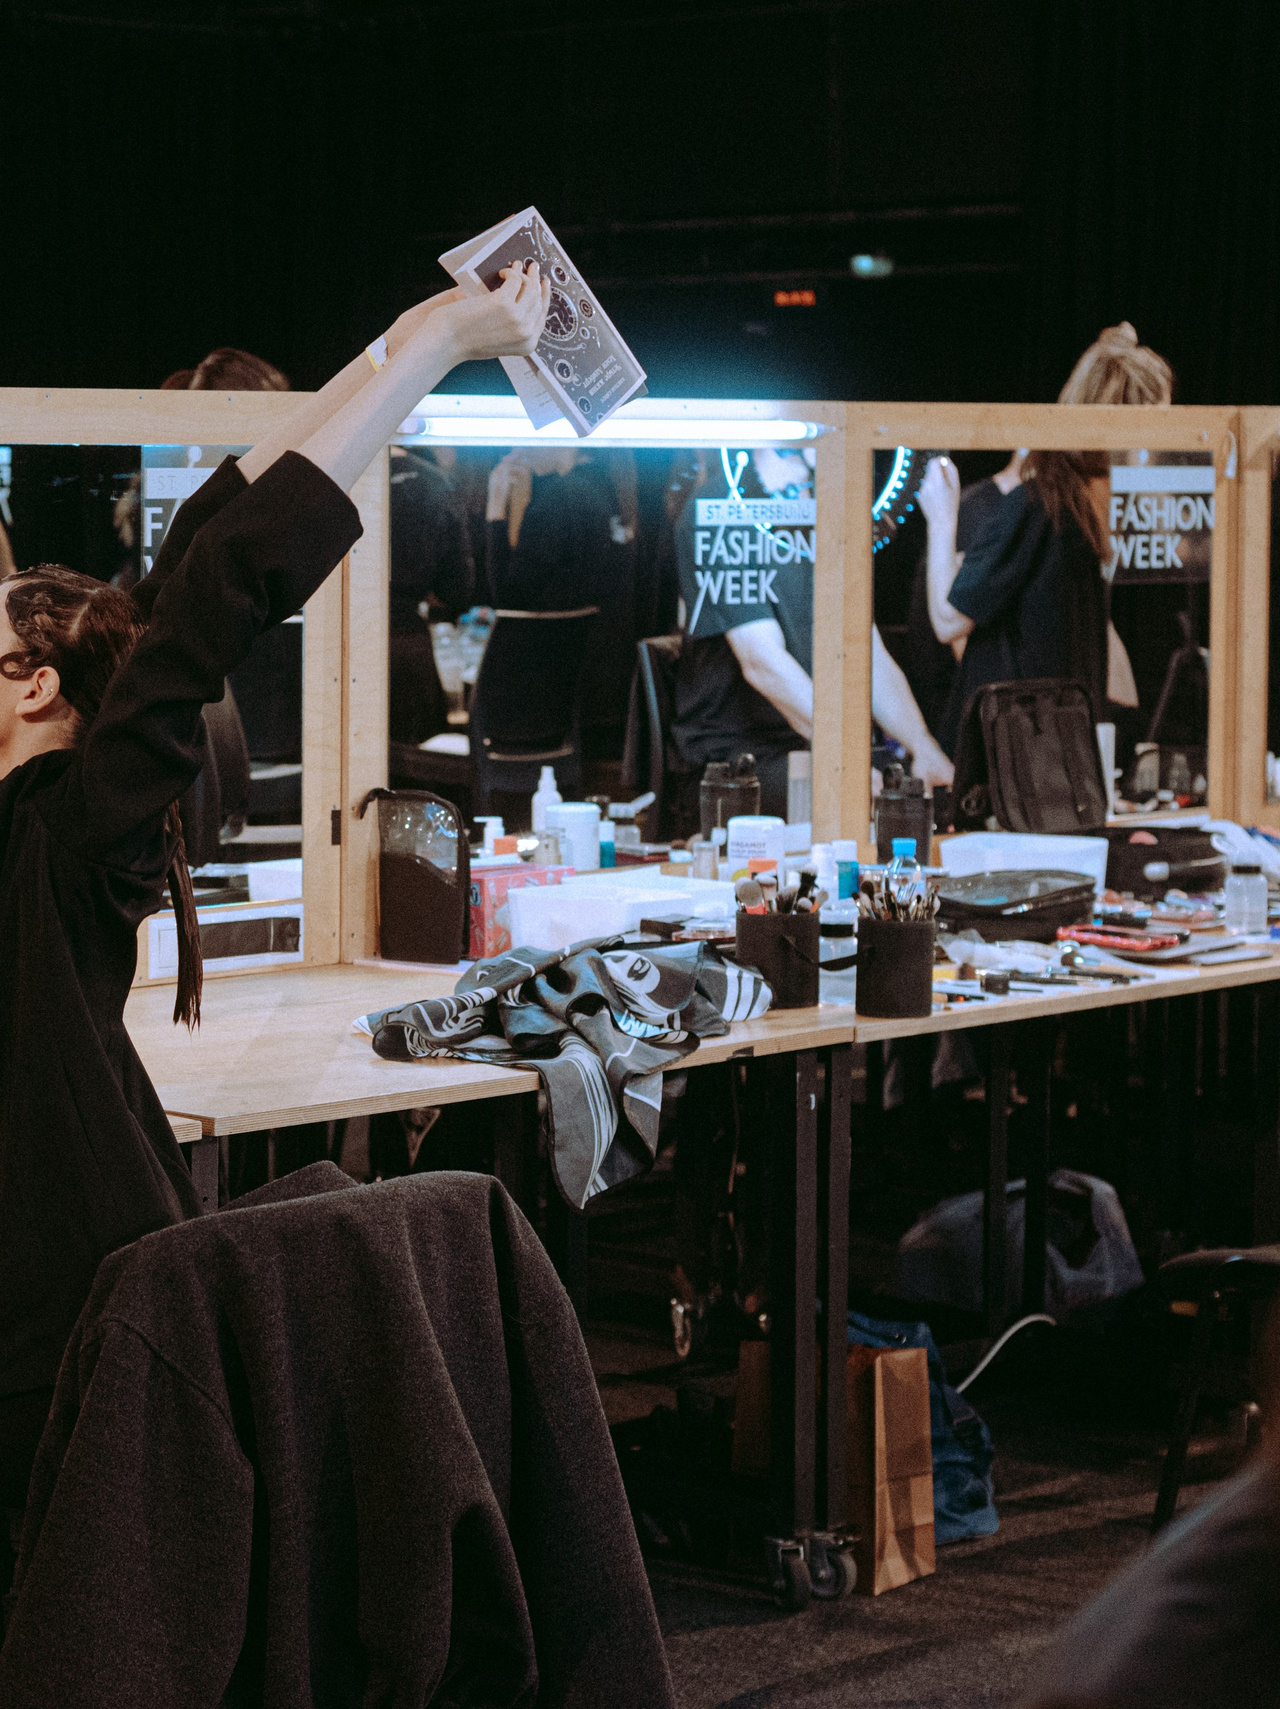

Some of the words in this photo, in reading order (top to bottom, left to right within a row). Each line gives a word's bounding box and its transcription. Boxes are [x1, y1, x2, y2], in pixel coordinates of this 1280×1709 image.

[1109, 495, 1215, 532] FASHION
[694, 529, 816, 566] FASHION
[1109, 533, 1184, 569] WEEK
[694, 569, 780, 606] WEEK
